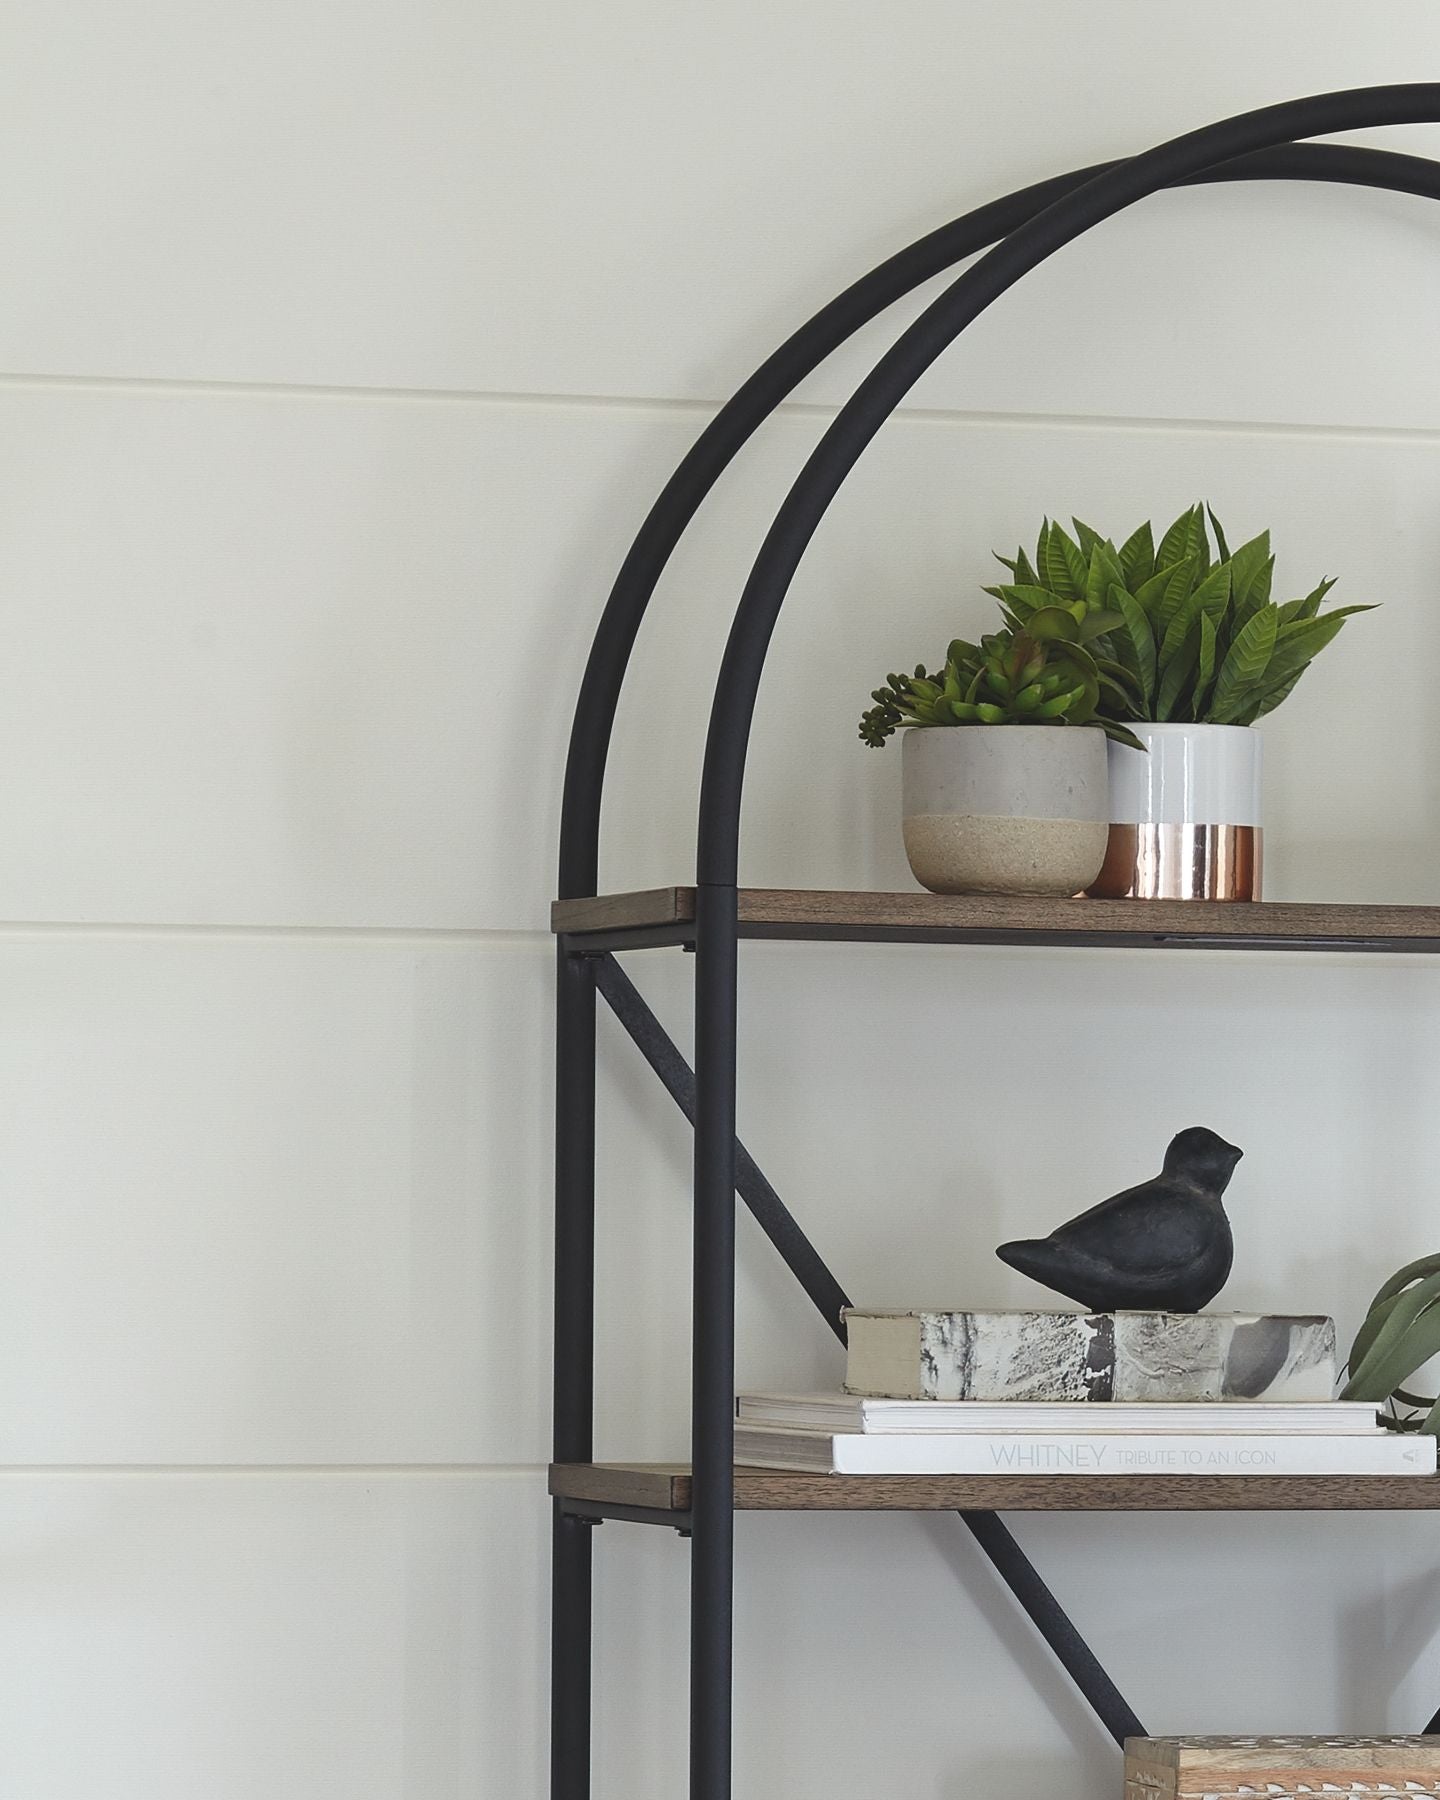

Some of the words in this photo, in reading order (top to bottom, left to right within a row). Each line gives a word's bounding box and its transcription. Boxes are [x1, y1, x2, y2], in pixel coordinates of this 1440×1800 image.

[989, 1444, 1108, 1467] WHITNEY
[1115, 1450, 1177, 1465] TRIBUTE
[1180, 1450, 1203, 1465] TO
[1206, 1450, 1230, 1465] AN
[1234, 1450, 1277, 1465] ICON
